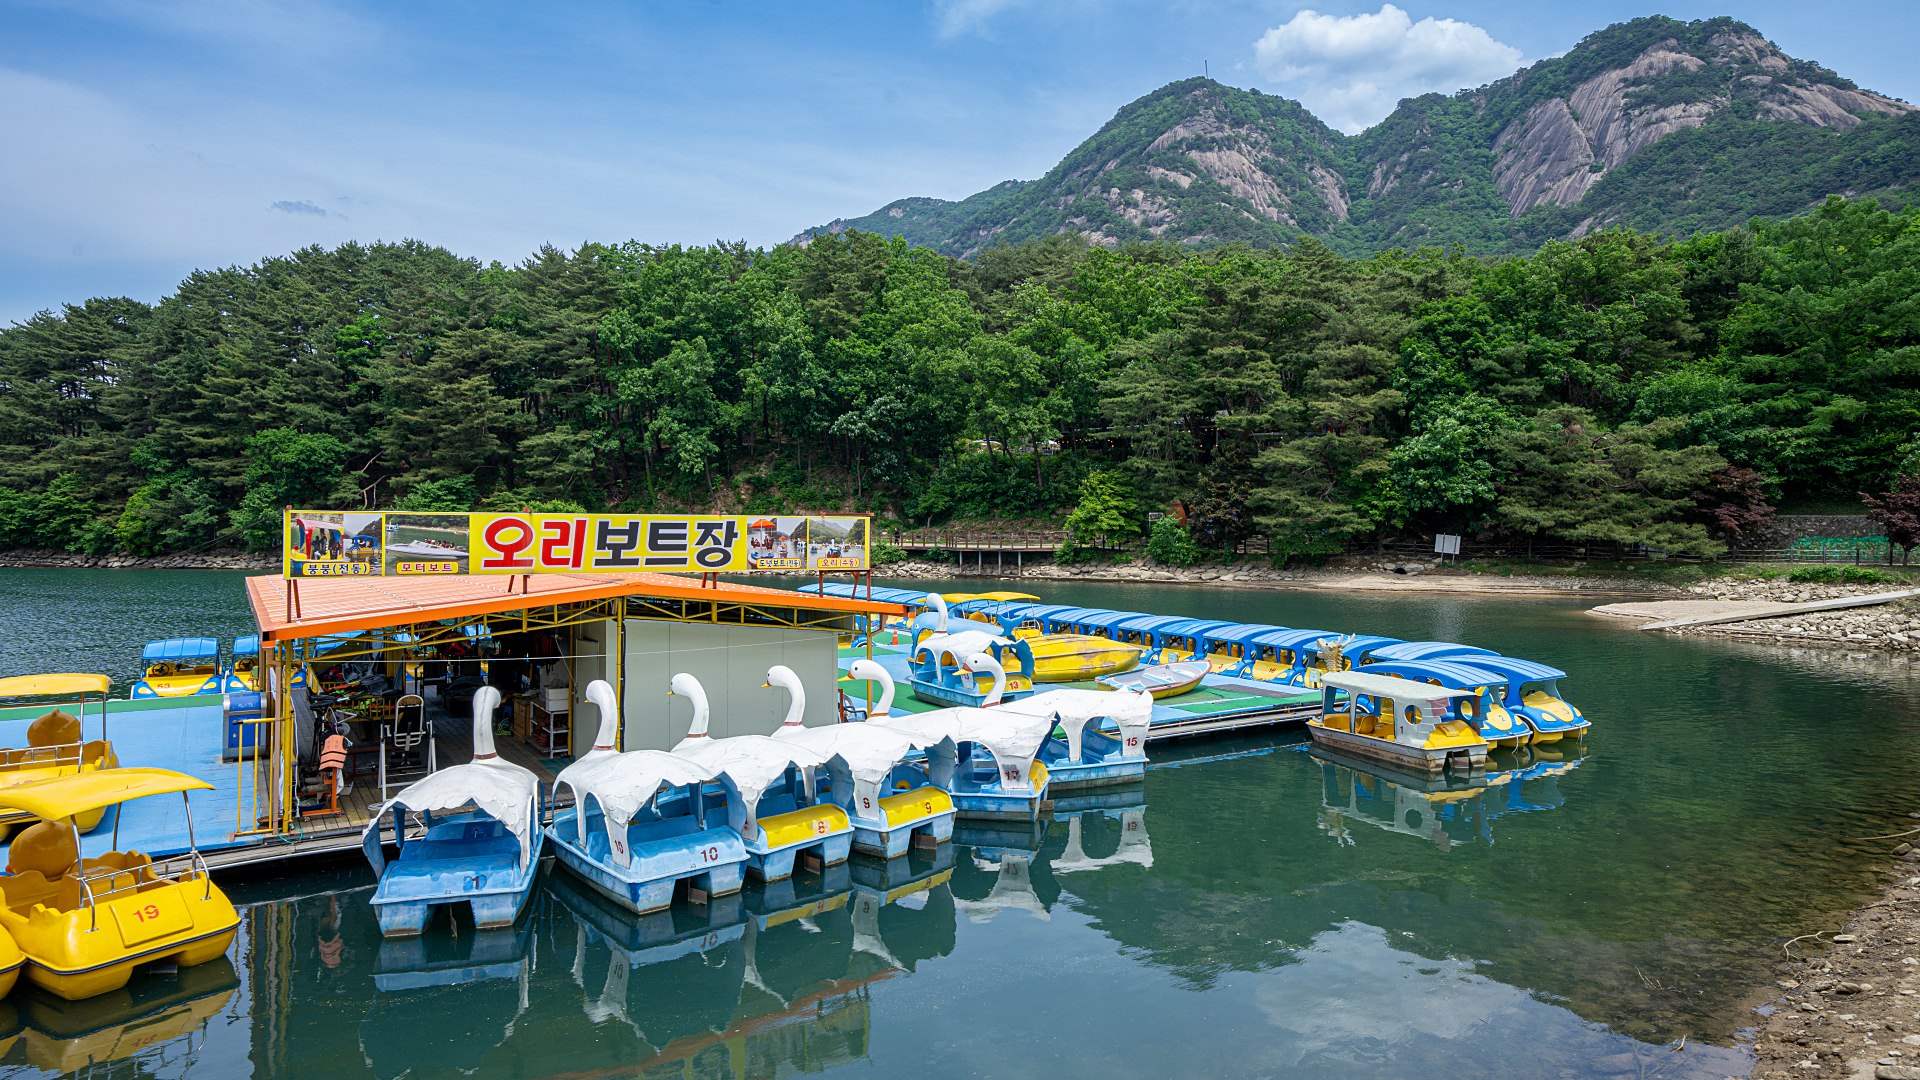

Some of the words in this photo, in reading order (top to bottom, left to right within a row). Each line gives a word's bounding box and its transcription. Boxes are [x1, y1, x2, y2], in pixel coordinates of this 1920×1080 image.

[483, 517, 739, 570] 오리보트장
[307, 563, 367, 575] 붕붕(전동)
[400, 563, 453, 573] 모터보트
[1009, 681, 1019, 690] 13
[1126, 737, 1138, 747] 15
[1004, 769, 1020, 781] 17
[614, 839, 624, 855] 10
[700, 846, 719, 863] 10
[132, 904, 160, 923] 19
